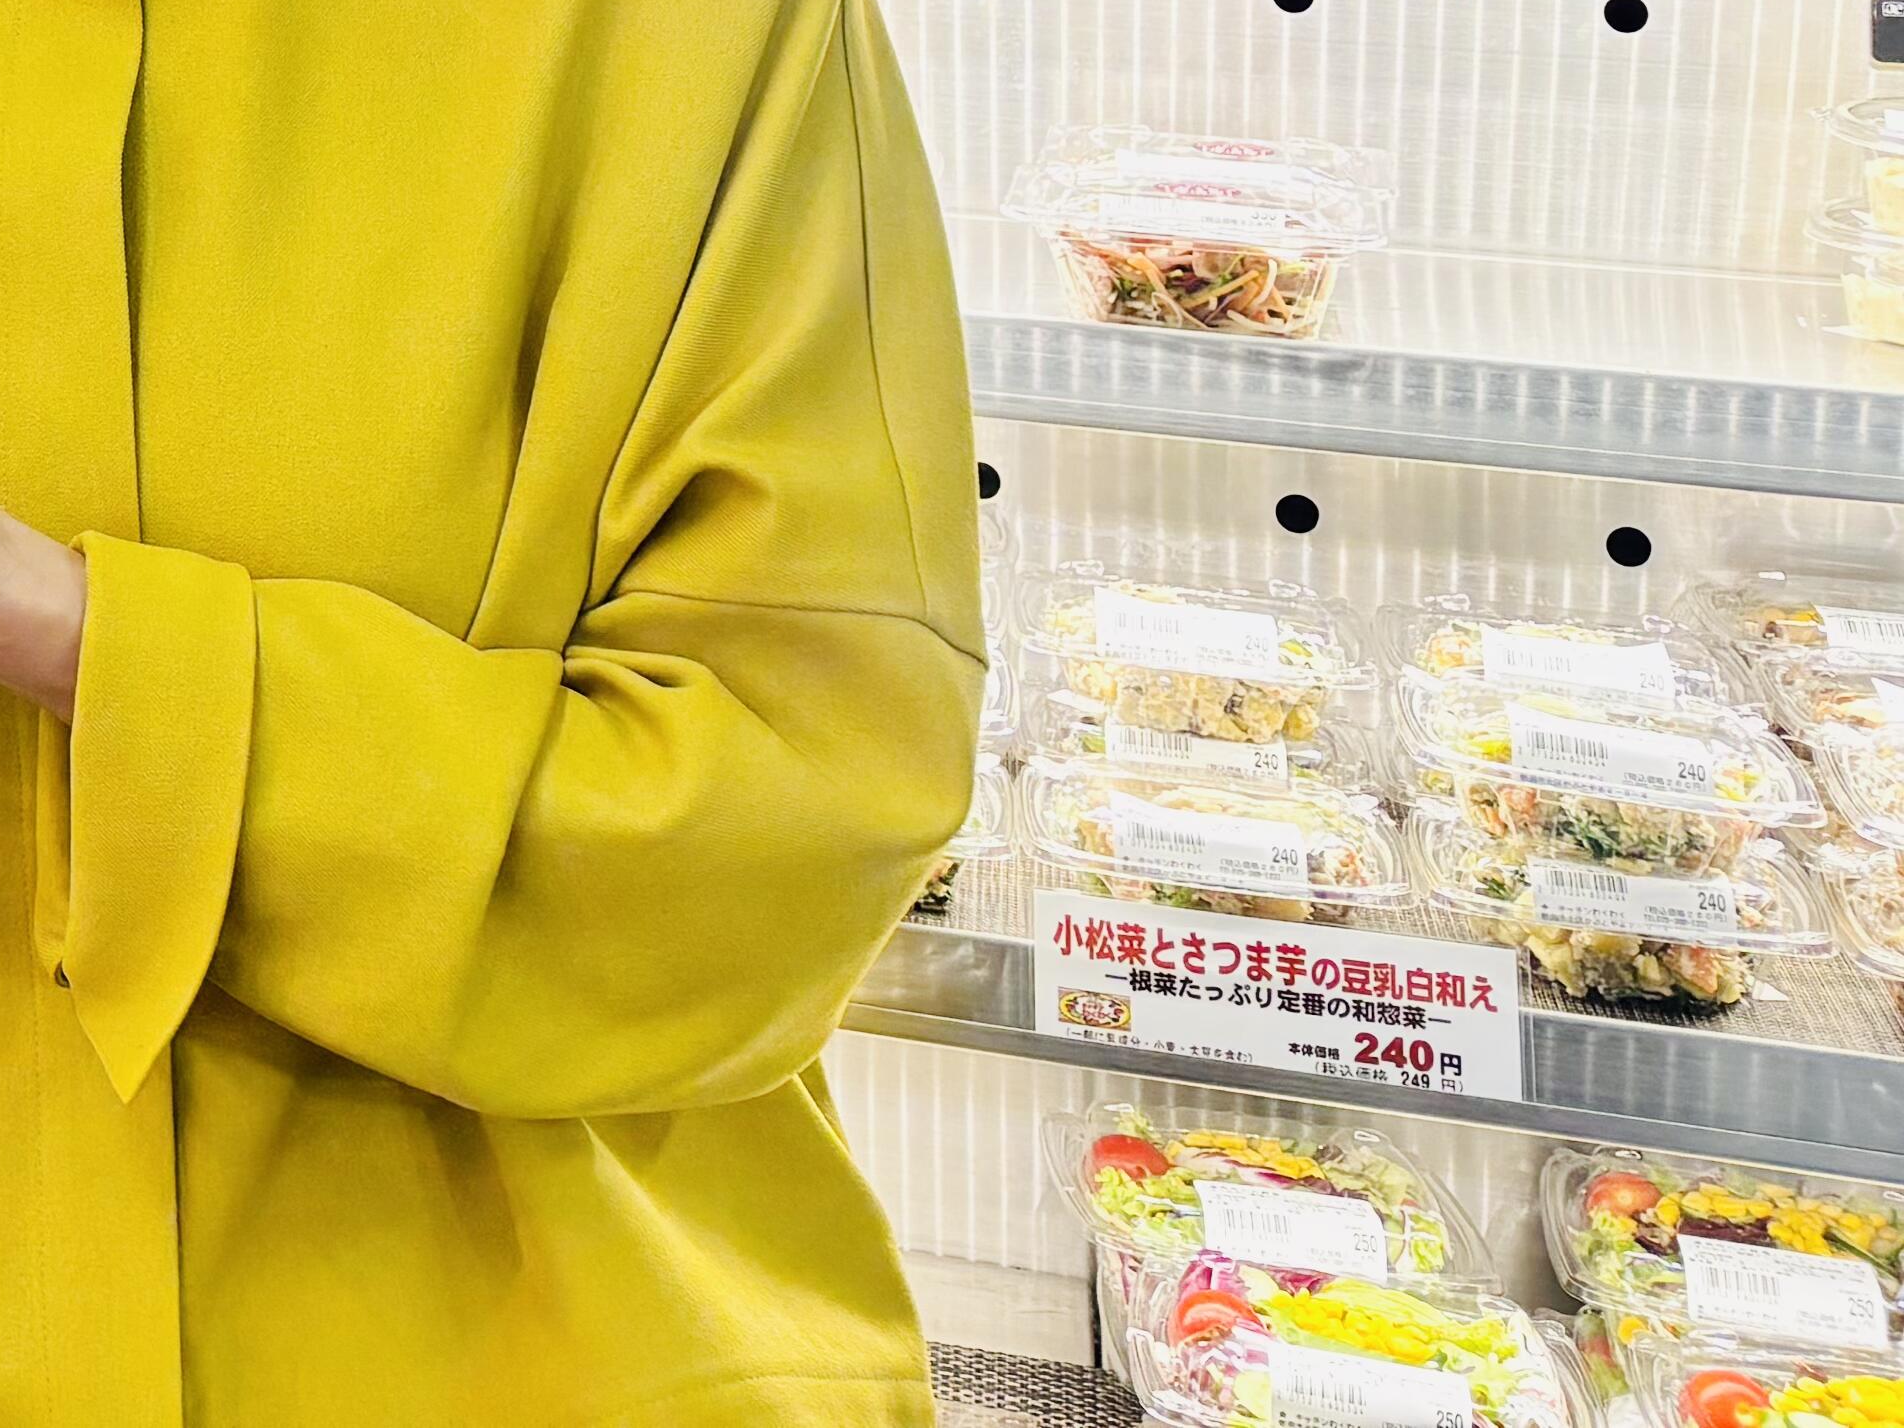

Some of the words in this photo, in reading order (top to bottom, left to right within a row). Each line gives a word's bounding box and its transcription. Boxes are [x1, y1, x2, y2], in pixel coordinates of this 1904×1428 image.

[1254, 752, 1279, 770] 240
[1677, 761, 1706, 782] 240
[1272, 847, 1298, 867] 240
[1698, 892, 1726, 912] 240
[1053, 914, 1498, 1013] 小松菜とさつま芋の豆乳白和え
[1288, 1042, 1340, 1061] 本体価格
[1354, 1232, 1378, 1253] 250
[1849, 1297, 1875, 1320] 250
[1436, 1410, 1464, 1428] 250
